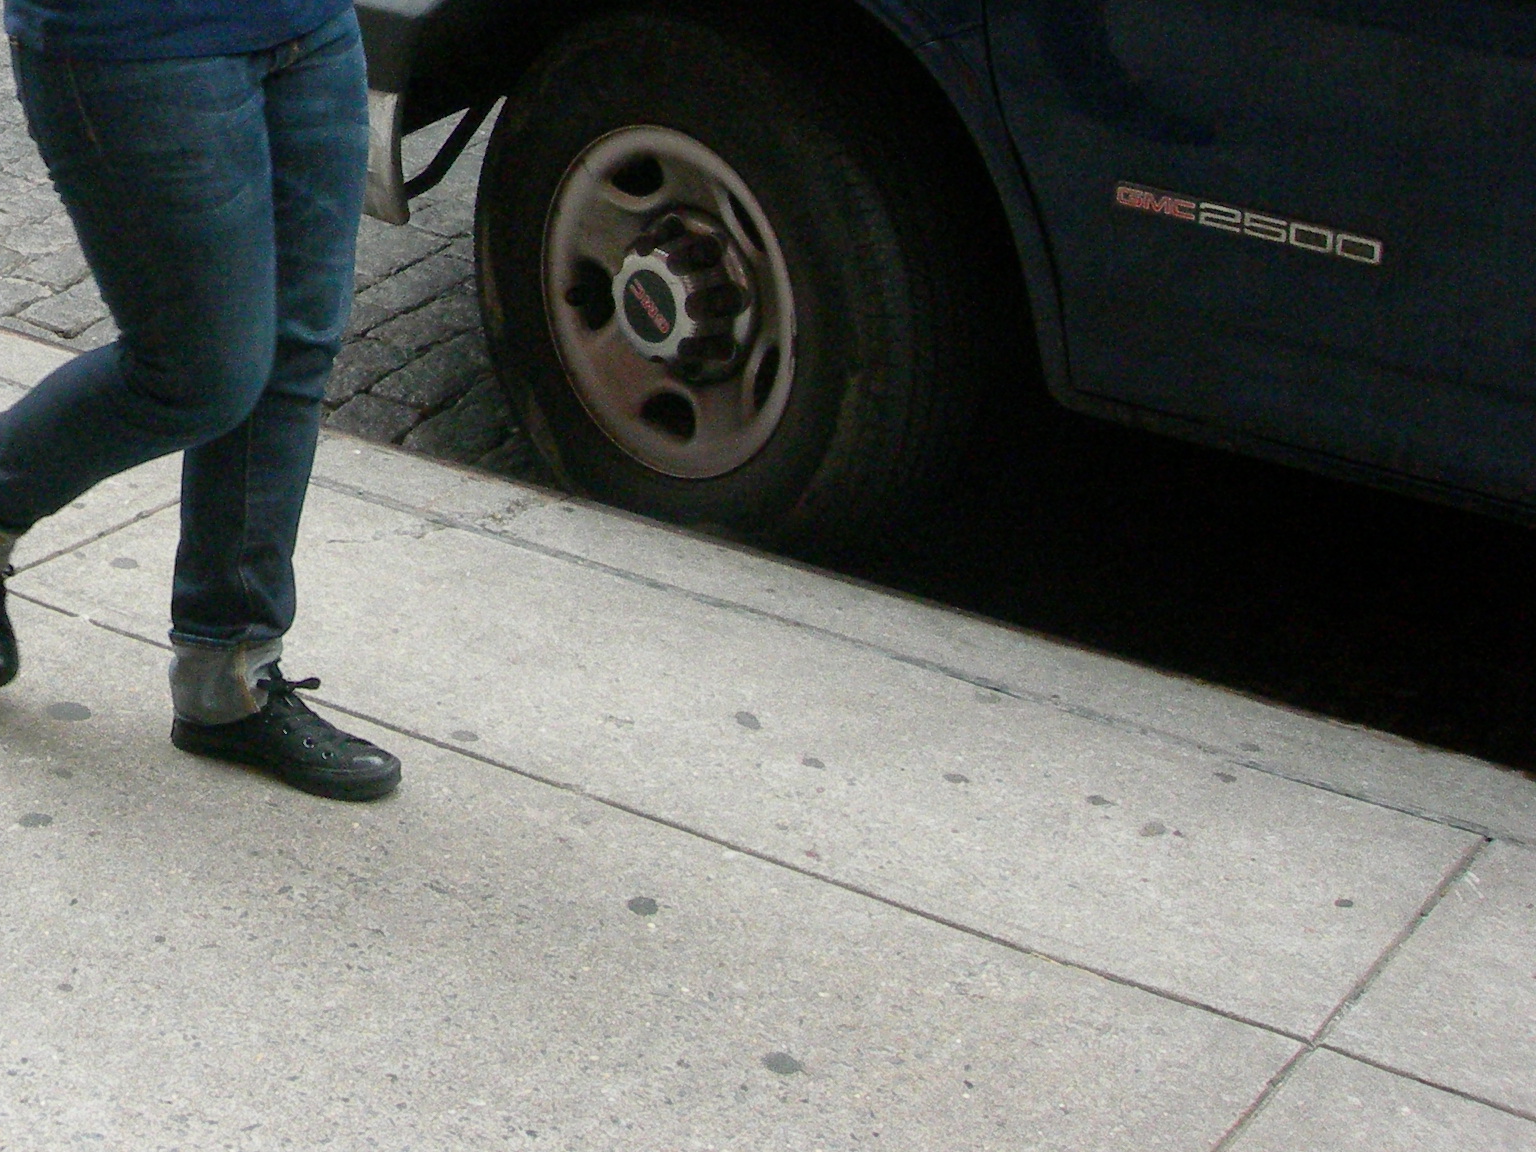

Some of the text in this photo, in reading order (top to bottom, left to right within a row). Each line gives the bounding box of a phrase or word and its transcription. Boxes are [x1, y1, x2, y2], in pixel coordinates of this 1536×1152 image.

[1116, 185, 1383, 264] GMC 2500
[630, 278, 670, 334] GMC
